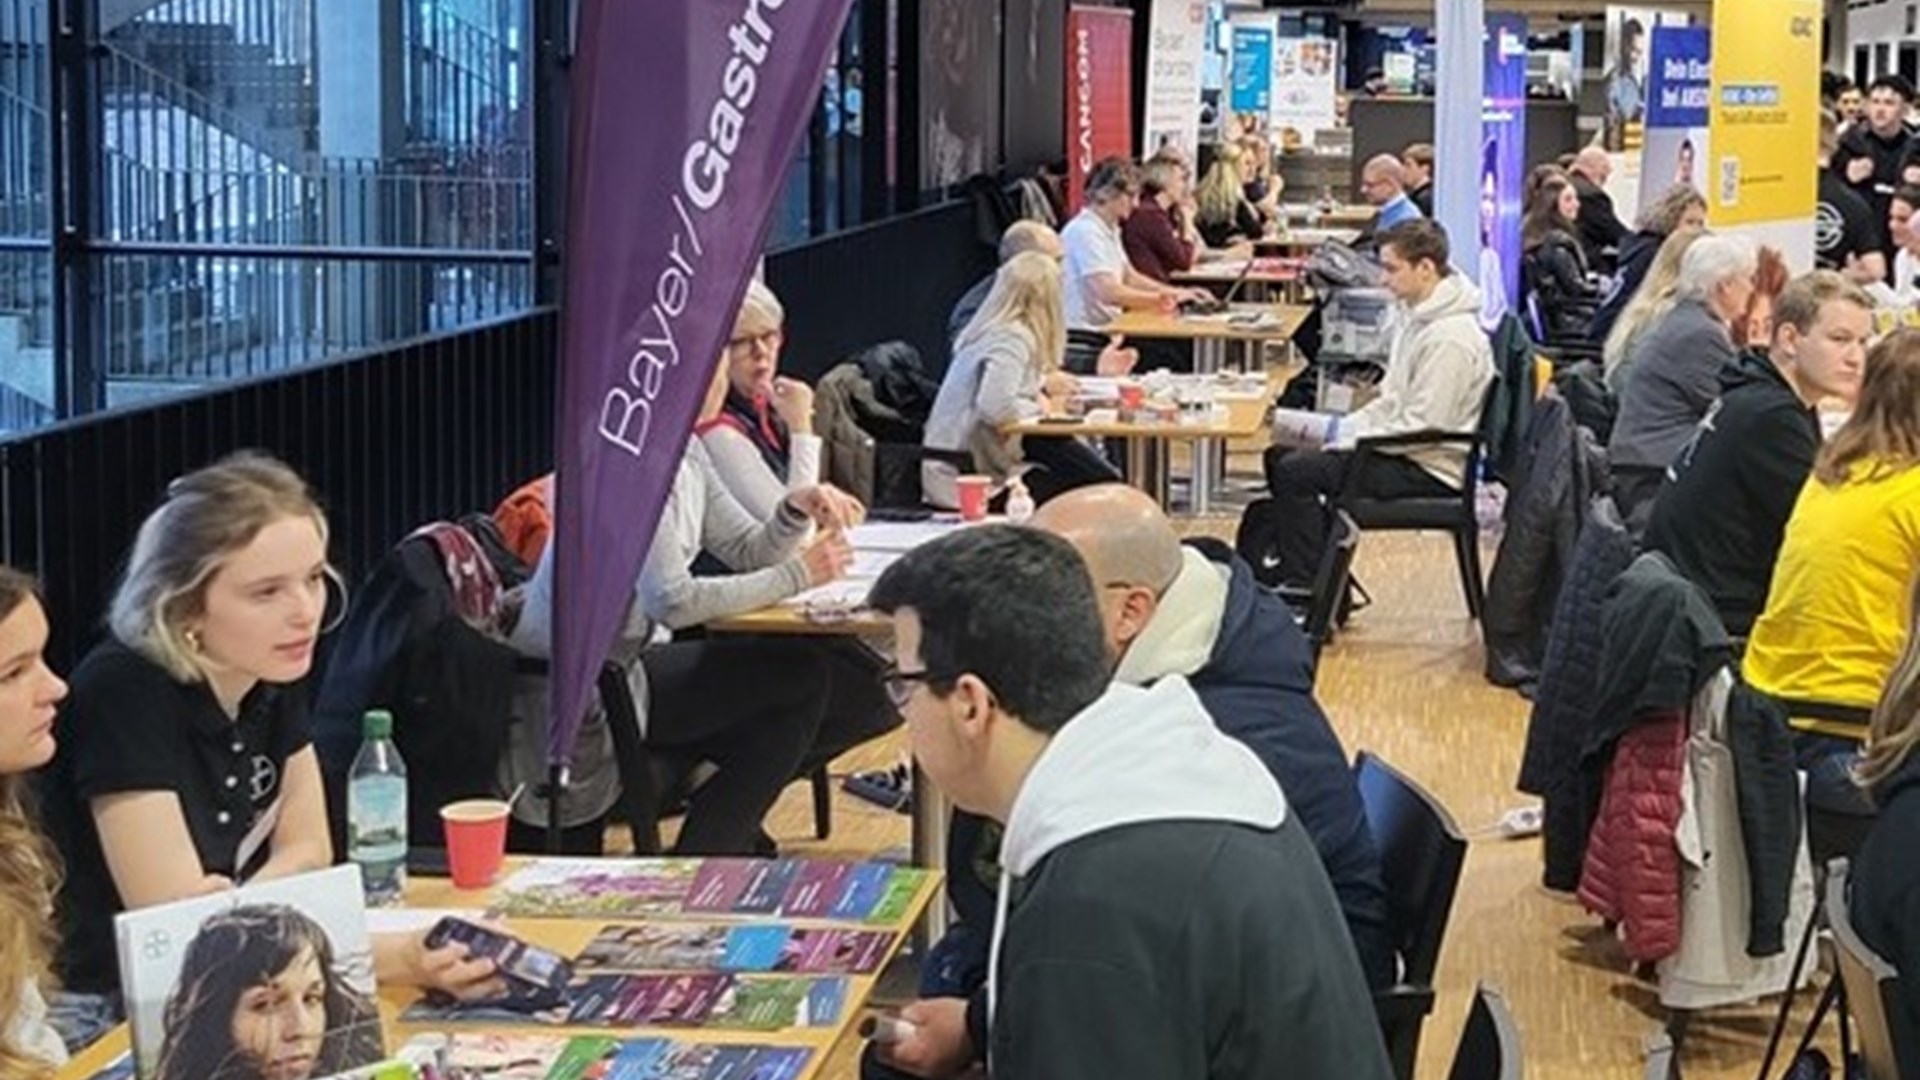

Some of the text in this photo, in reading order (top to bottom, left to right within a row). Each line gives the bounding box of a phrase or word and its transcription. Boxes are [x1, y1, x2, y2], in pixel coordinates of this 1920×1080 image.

[1076, 29, 1093, 174] CANCOM
[1663, 57, 1687, 80] Dein
[598, 0, 784, 455] Bayer/Gastr
